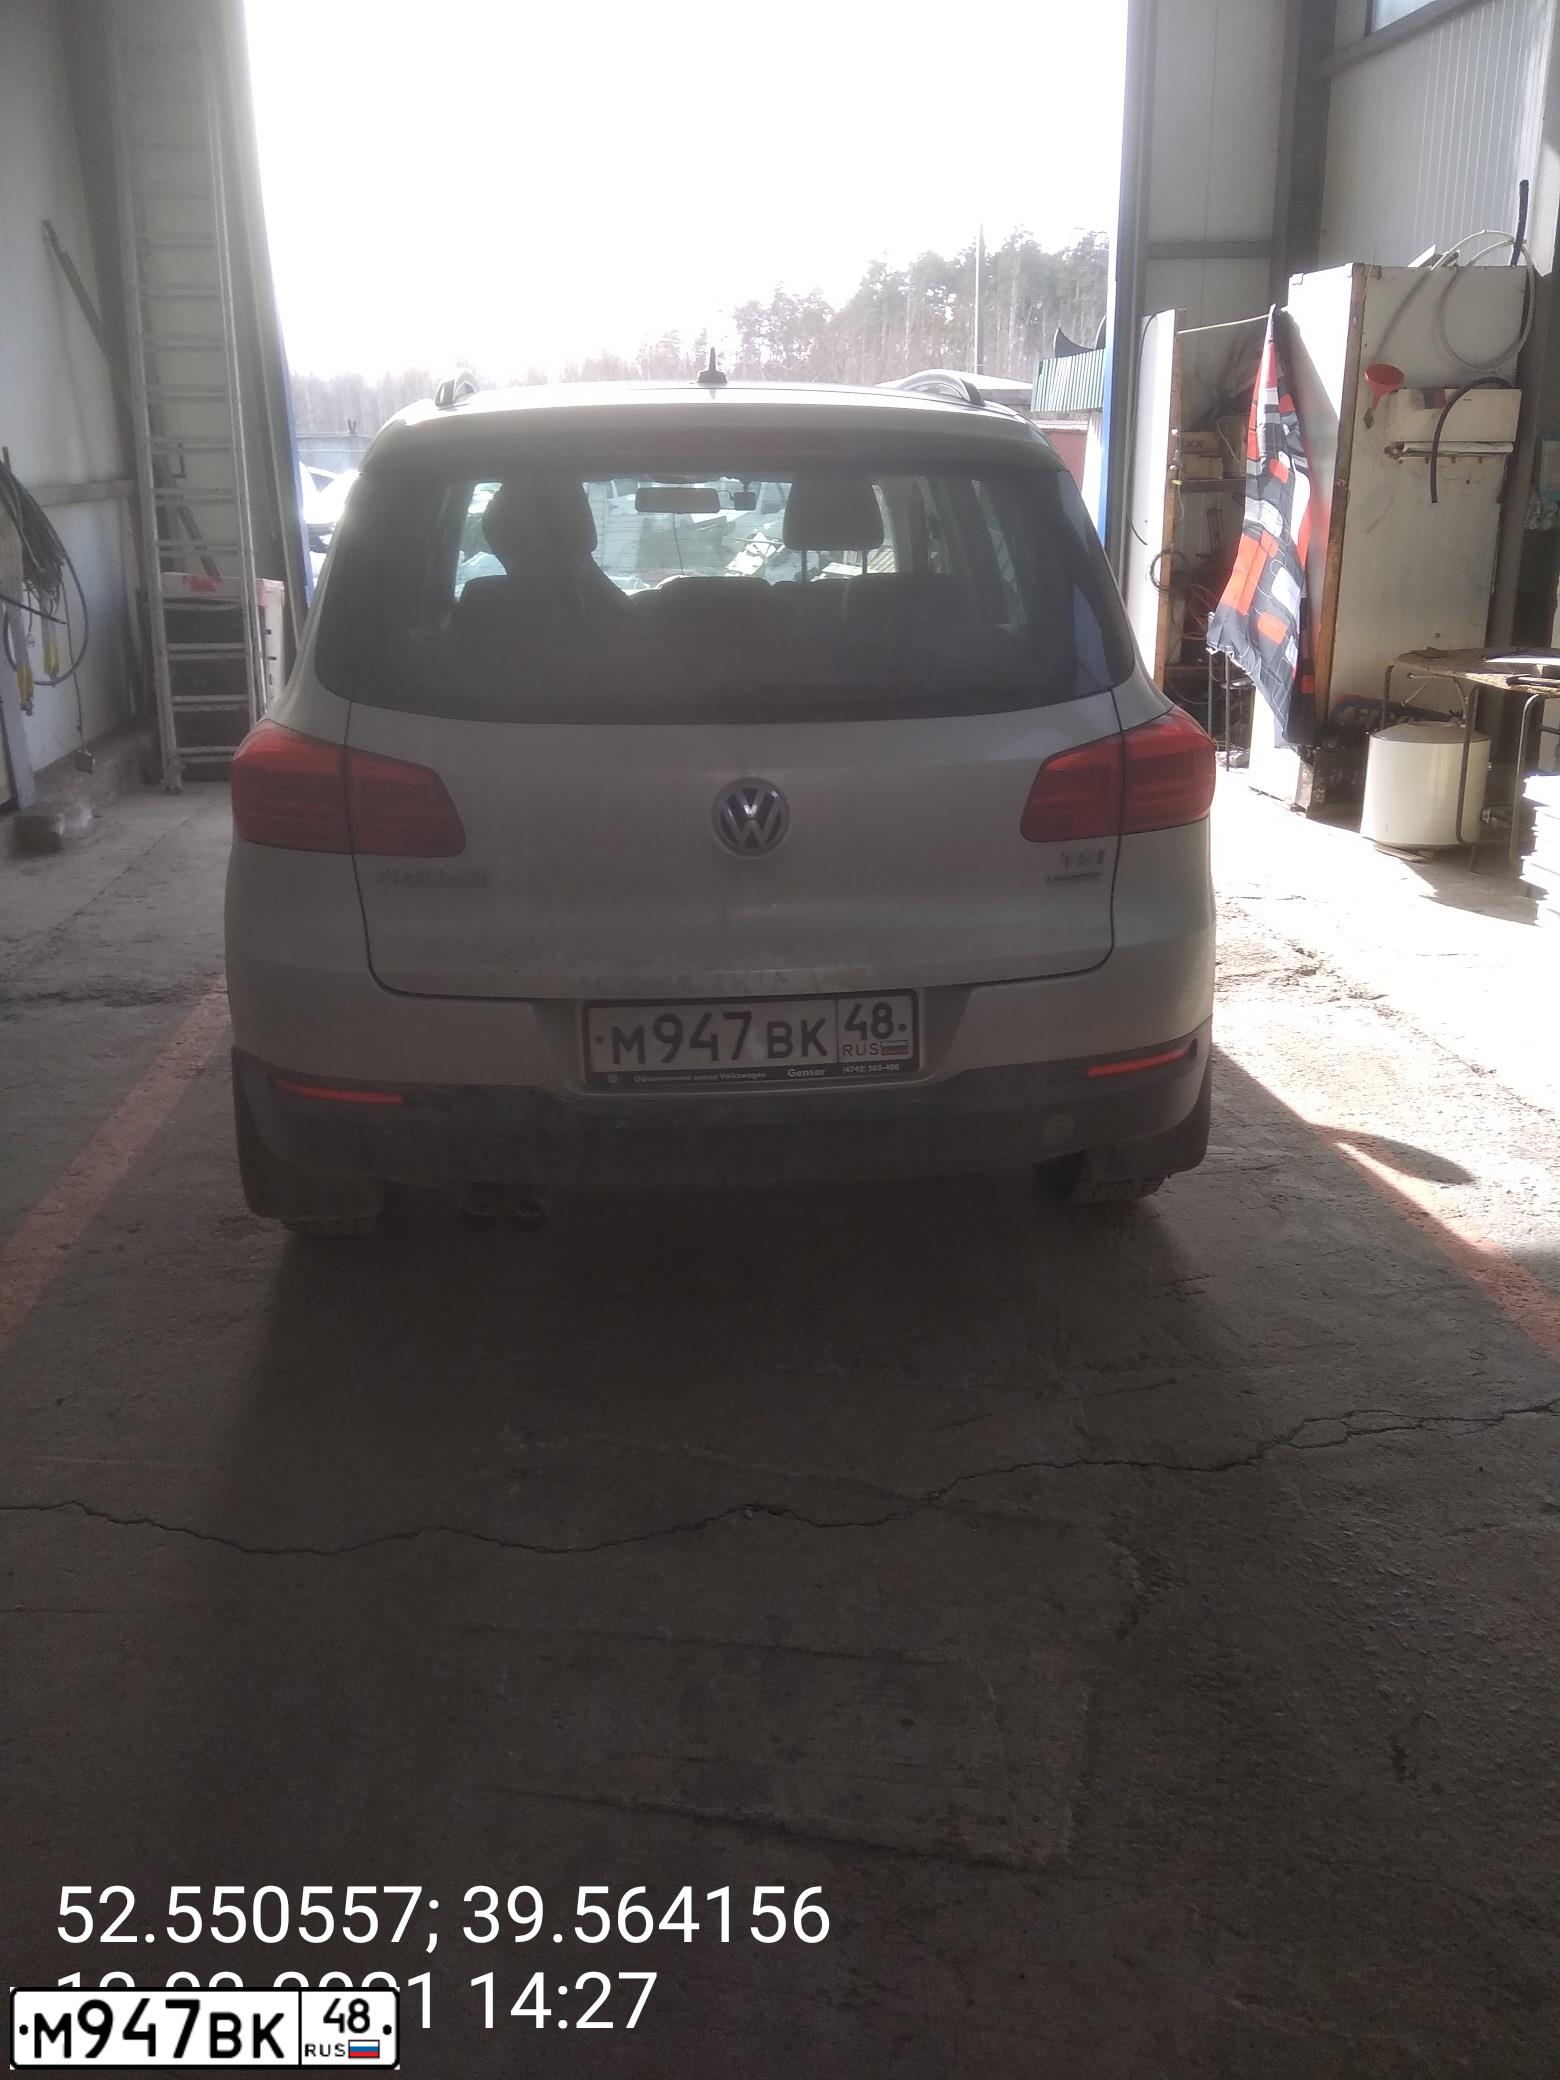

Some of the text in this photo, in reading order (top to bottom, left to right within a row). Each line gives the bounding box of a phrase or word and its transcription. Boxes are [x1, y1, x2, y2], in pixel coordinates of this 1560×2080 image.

[844, 1001, 894, 1041] 48
[842, 1041, 881, 1057] RUS
[787, 1067, 826, 1078] Genser
